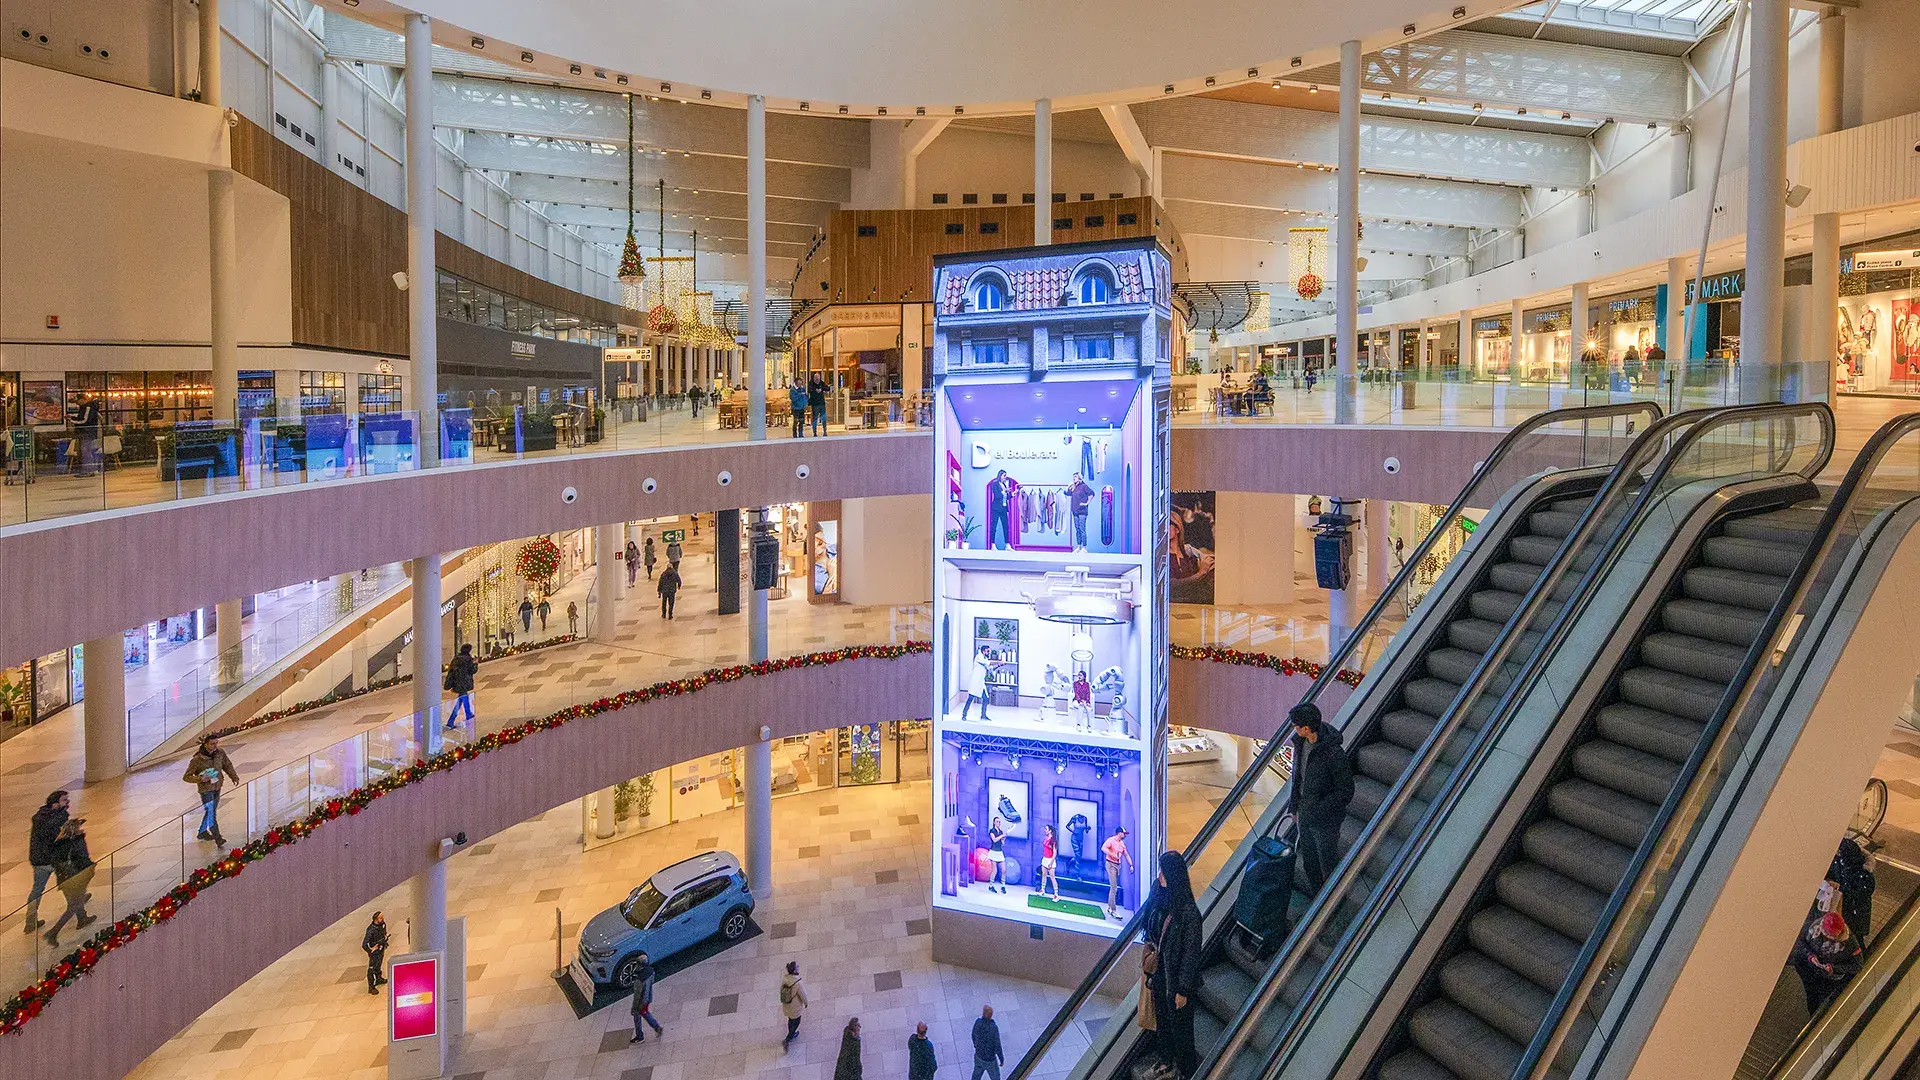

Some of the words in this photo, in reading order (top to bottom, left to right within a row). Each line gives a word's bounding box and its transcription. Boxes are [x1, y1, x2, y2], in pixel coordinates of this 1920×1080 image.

[1608, 298, 1640, 312] PRIMARK
[511, 340, 526, 354] FITNESS
[526, 343, 536, 355] PARK
[1007, 447, 1058, 459] Boulevard
